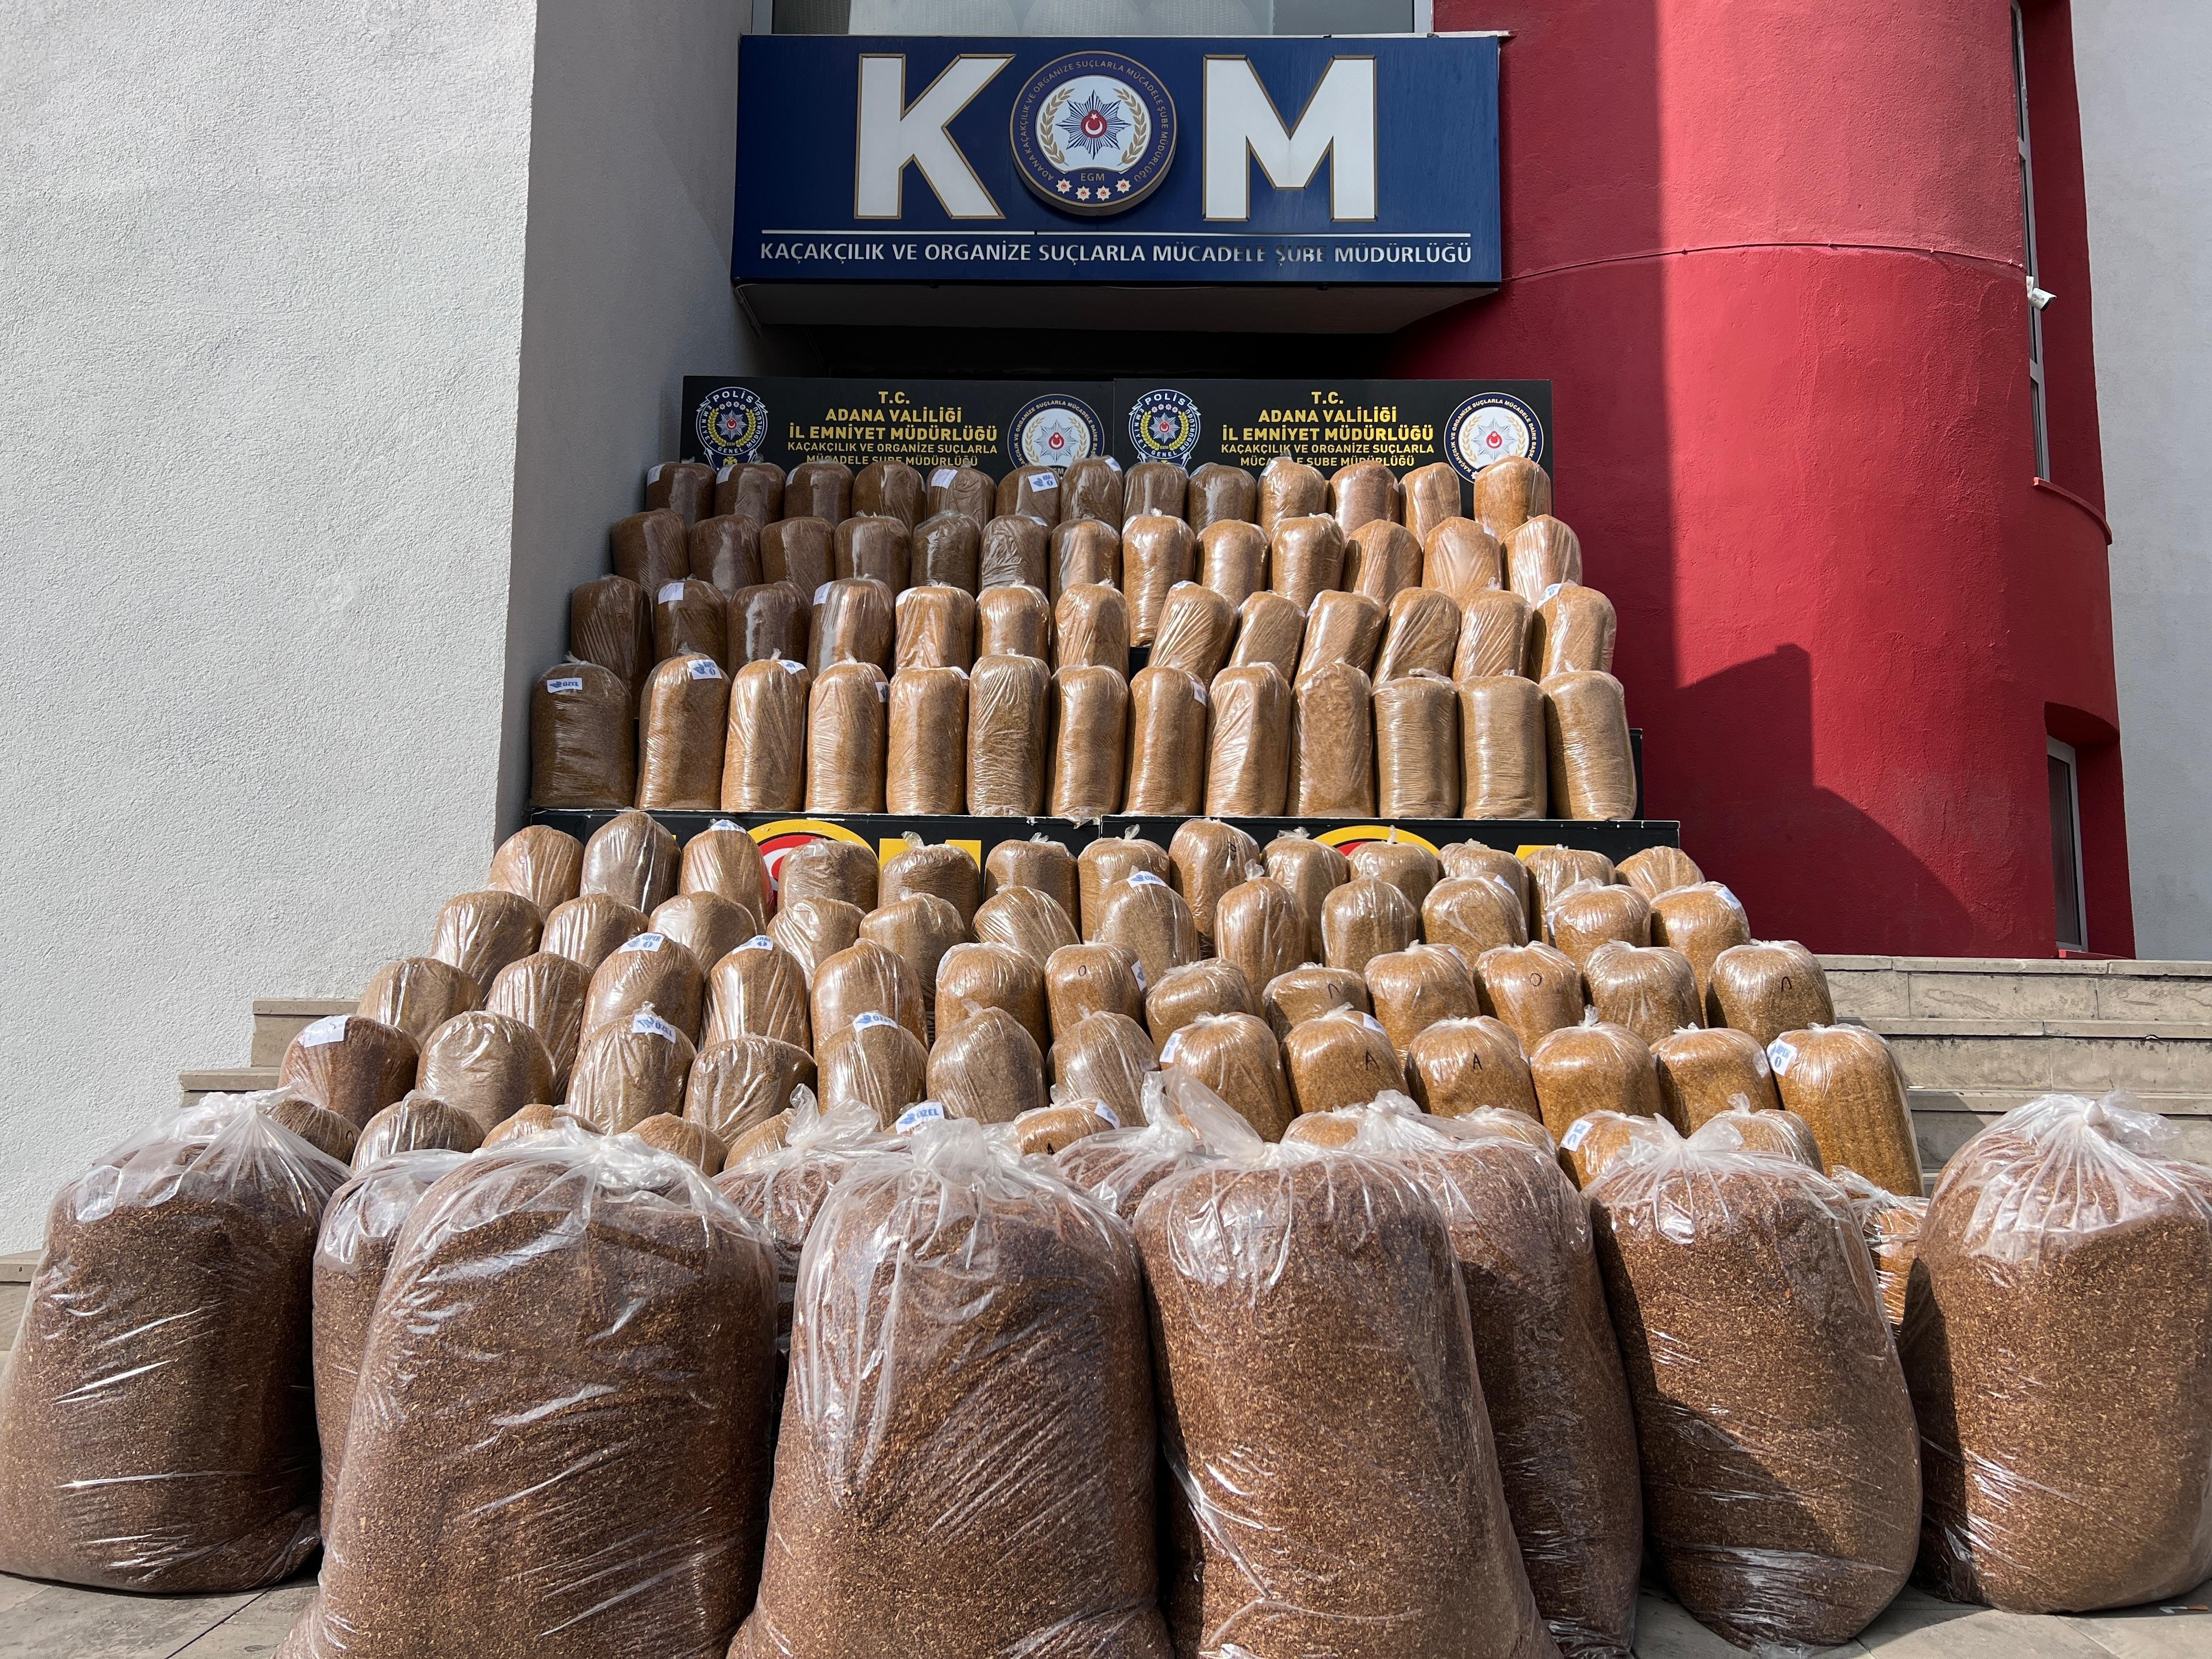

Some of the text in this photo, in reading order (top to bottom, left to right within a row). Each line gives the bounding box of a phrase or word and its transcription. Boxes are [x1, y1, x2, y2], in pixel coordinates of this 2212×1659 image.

[1075, 59, 1125, 72] SUÇLARLA
[1033, 62, 1075, 93] ORGANİZE
[1126, 67, 1164, 106] MÜCADELE
[1027, 92, 1036, 104] VE
[1156, 105, 1169, 129] ŞUBE
[1019, 106, 1032, 155] KAÇAKÇILIK
[1029, 154, 1055, 181] ADANA
[1080, 172, 1105, 182] EGM
[760, 240, 1471, 267] KAÇAKÇILIK VE ORGANİZE SUÇLARLA MÜCADELE ŞUBE MÜDÜRLÜĞÜ
[713, 390, 754, 403] POLİS
[878, 391, 910, 404] T.C.
[1144, 393, 1186, 406] POLİS
[1311, 391, 1344, 405] T.C.
[1472, 398, 1503, 408] SUÇLARLA
[825, 406, 962, 423] ADANA VALİLİĞİ
[1258, 406, 1397, 423] ADANA VALİLİĞİ
[789, 422, 998, 442] İL EMNİYET MÜDÜRLÜĞÜ
[1222, 424, 1434, 441] İL EMNİYET MÜDÜRLÜĞÜ
[718, 446, 744, 454] GENEL
[787, 442, 998, 456] KAÇAKÇILIK VE ORGANİZE SUÇLARLA
[1221, 442, 1435, 455] KAÇAKÇILIK VE ORGANİZE SUÇLARLA
[654, 1019, 674, 1038] ÖZEL
[1365, 1049, 1380, 1071] A
[1472, 1053, 1483, 1070] A
[916, 1107, 939, 1118] ÖZEL
